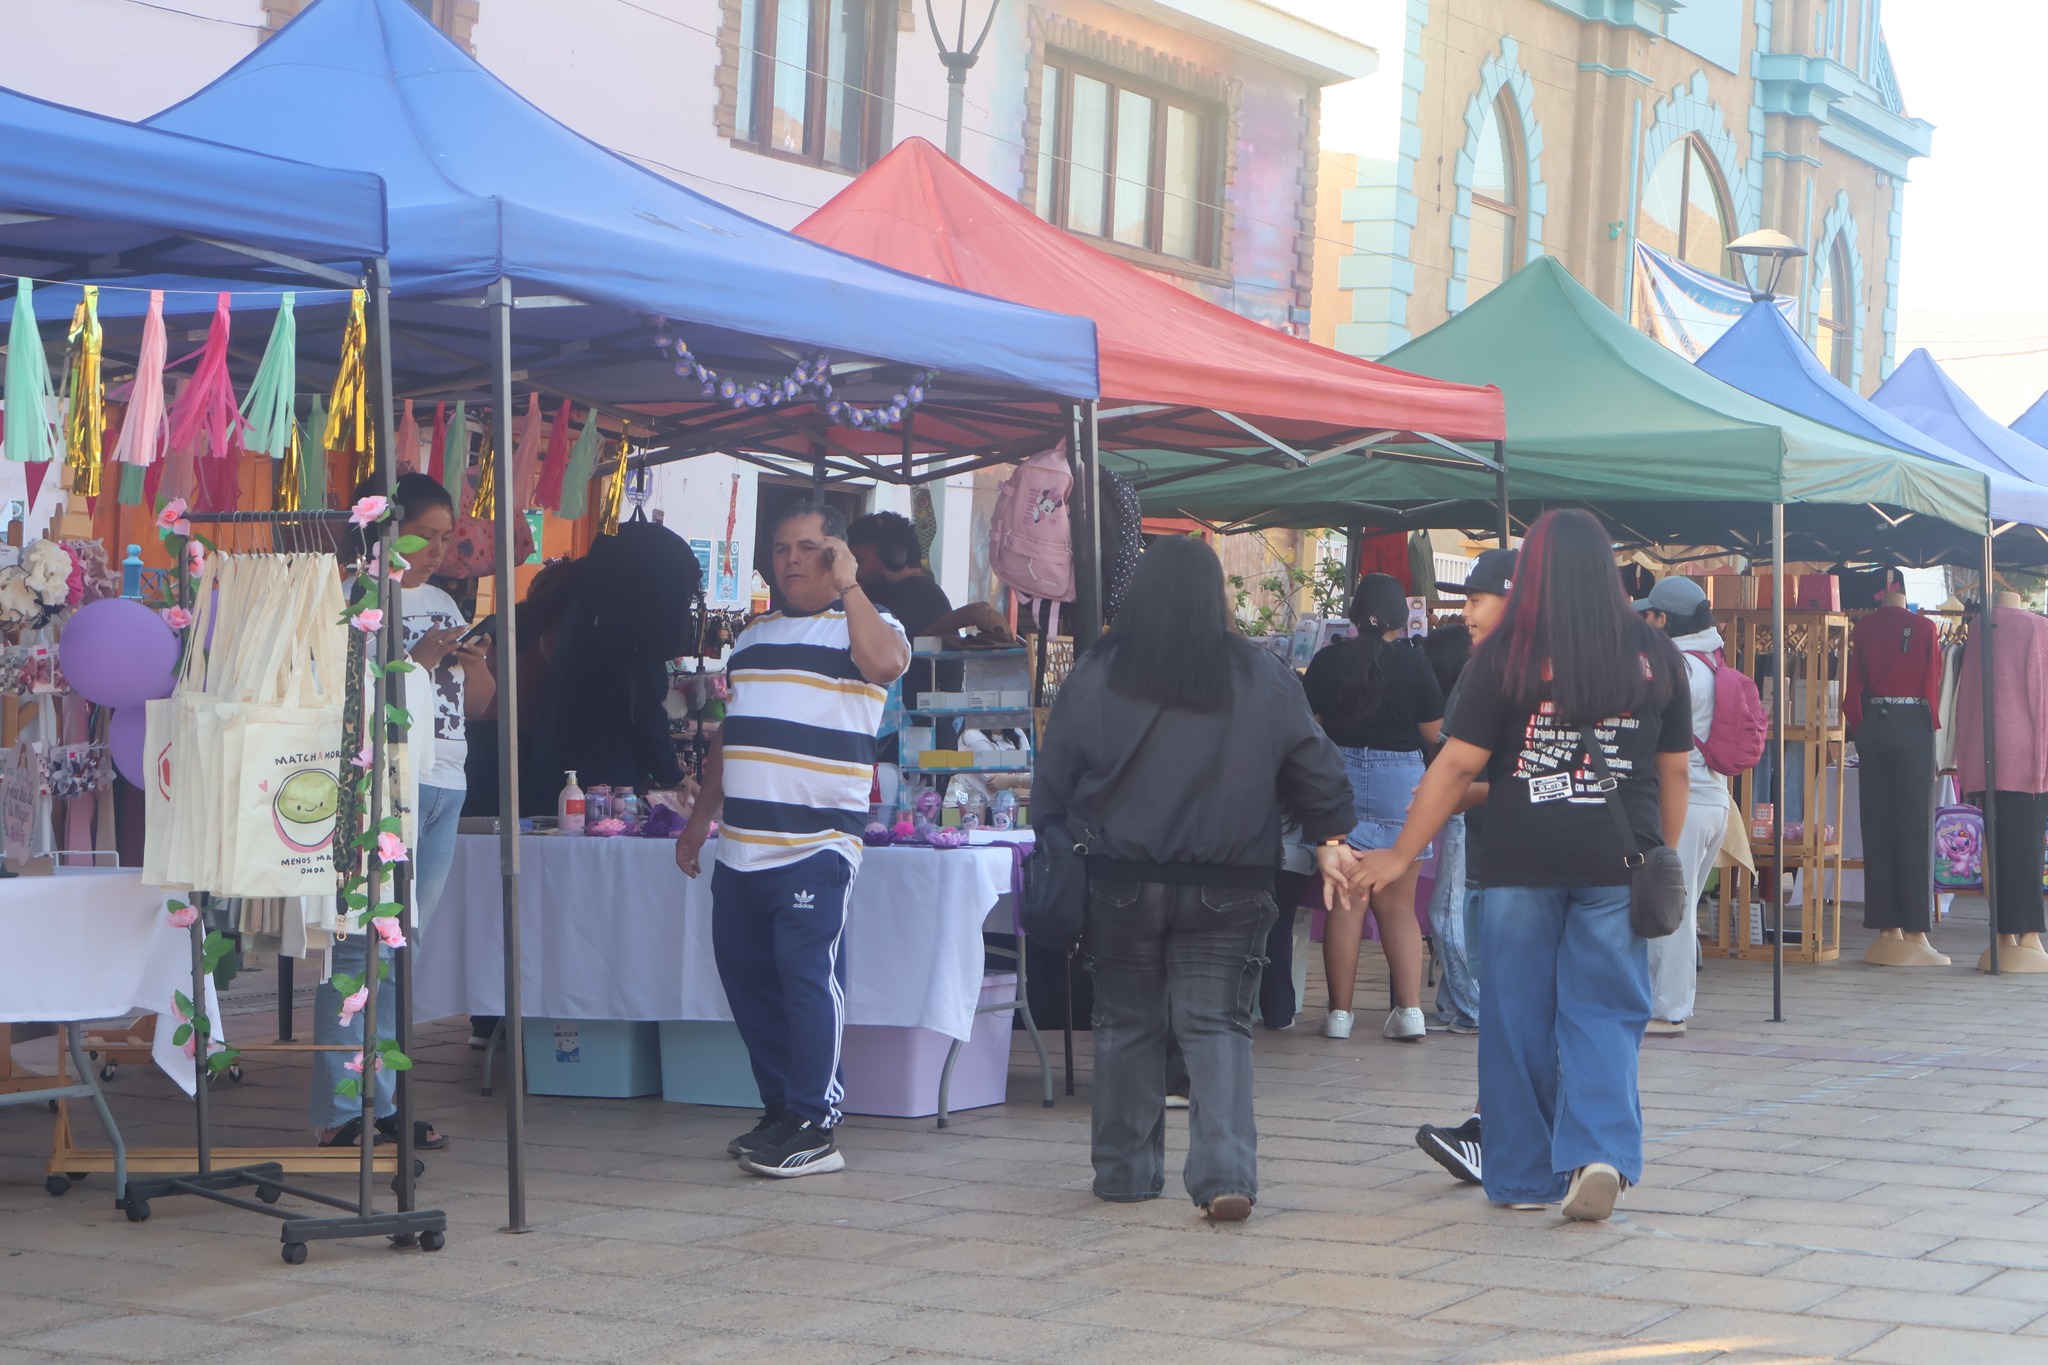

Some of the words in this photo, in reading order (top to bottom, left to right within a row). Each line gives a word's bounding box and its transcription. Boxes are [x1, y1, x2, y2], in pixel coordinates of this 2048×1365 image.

[629, 473, 649, 490] AT
[1533, 728, 1556, 741] Brigada
[1557, 730, 1565, 740] de
[281, 856, 311, 867] MENOS
[316, 854, 333, 862] MA
[300, 867, 326, 875] ONDA
